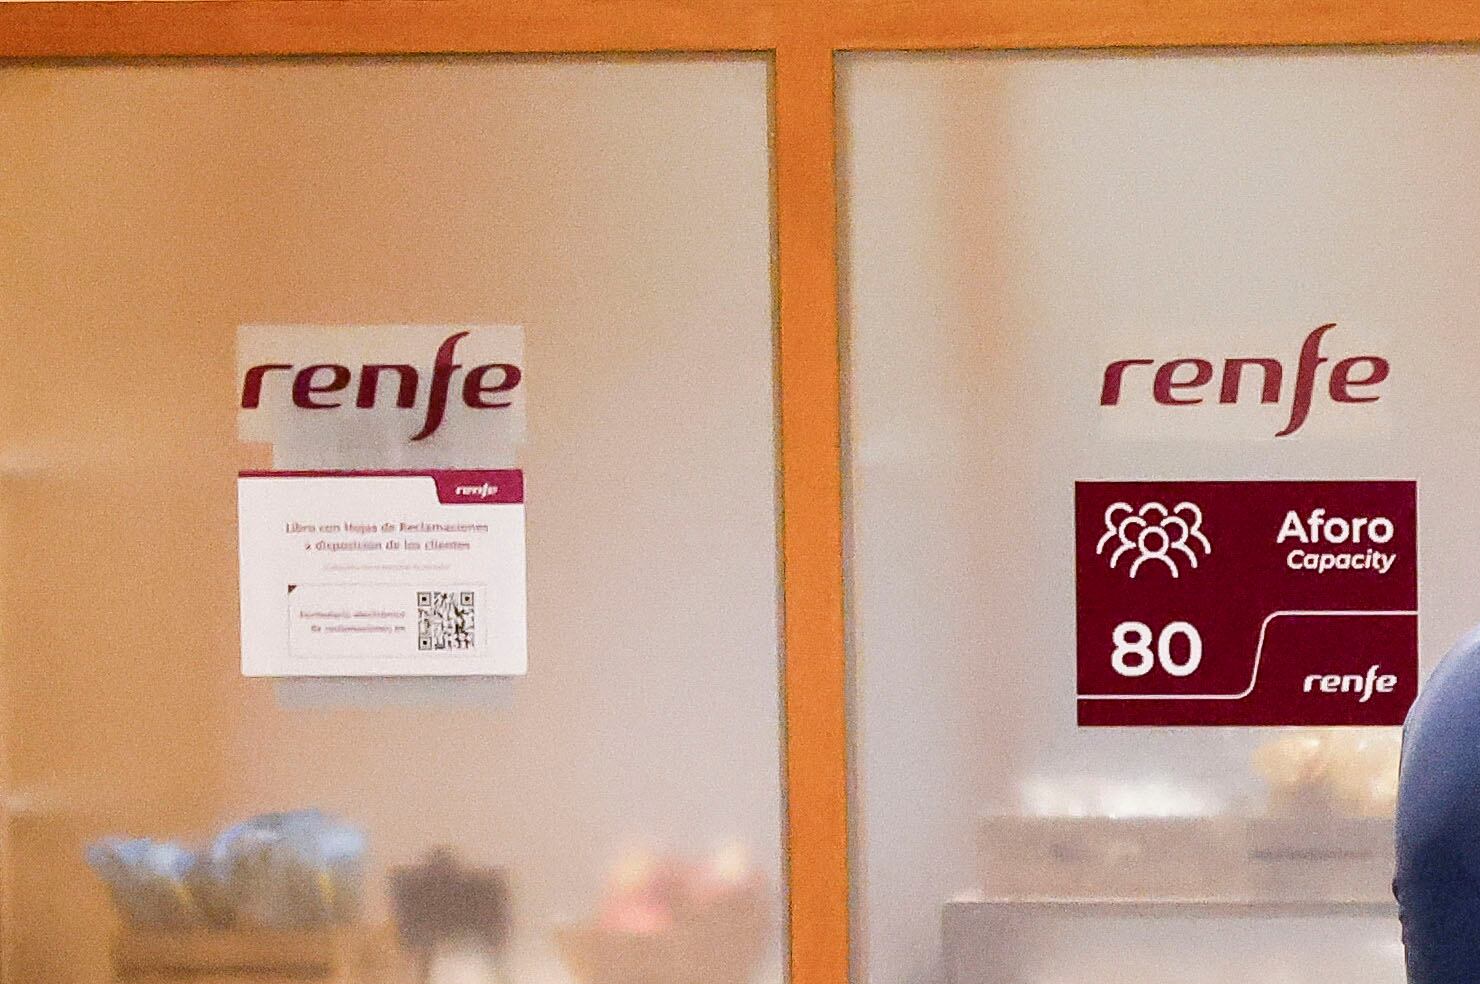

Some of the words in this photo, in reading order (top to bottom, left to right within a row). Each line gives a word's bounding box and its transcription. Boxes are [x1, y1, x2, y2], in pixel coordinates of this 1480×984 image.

[242, 331, 523, 442] renfe
[1100, 323, 1391, 438] renfe
[455, 482, 499, 500] renfe
[285, 521, 316, 534] Libro
[318, 523, 341, 533] con
[381, 521, 396, 533] de
[385, 539, 400, 551] de
[1276, 508, 1395, 545] Aforo
[1286, 548, 1398, 575] Capacity
[1111, 621, 1203, 678] 80
[1303, 664, 1399, 704] renfe
